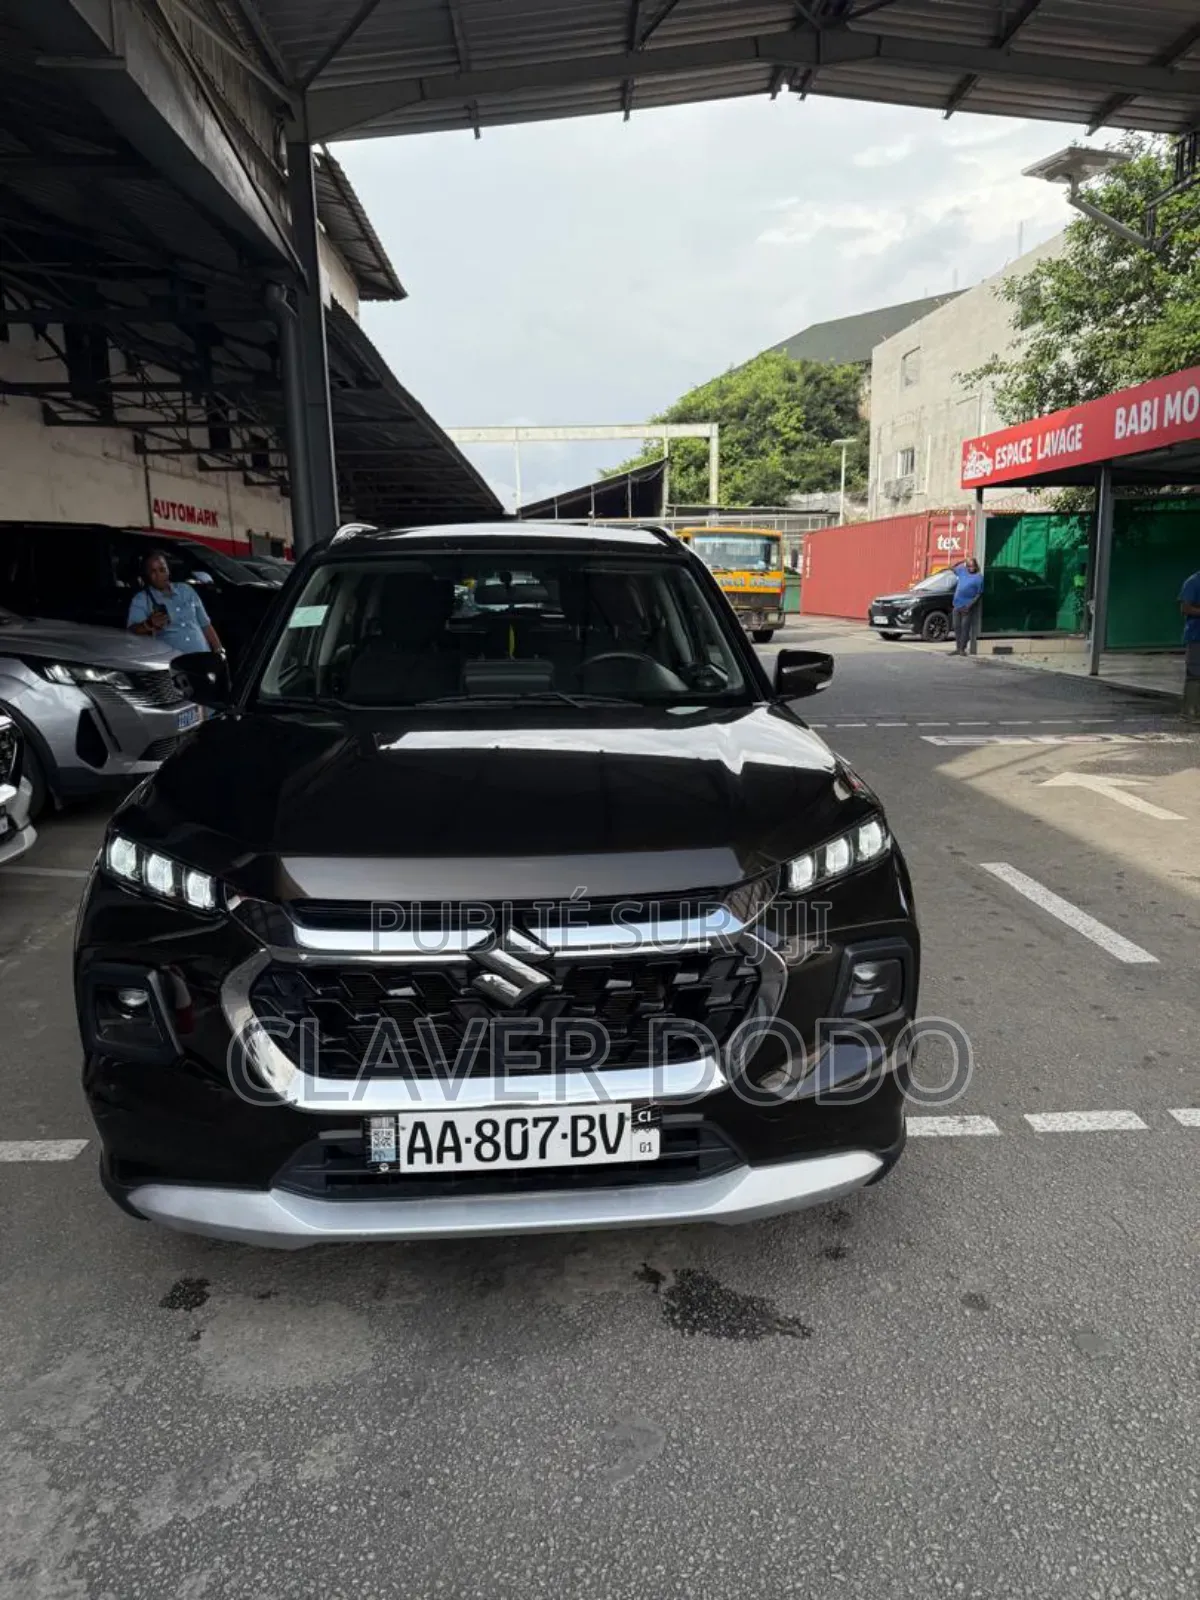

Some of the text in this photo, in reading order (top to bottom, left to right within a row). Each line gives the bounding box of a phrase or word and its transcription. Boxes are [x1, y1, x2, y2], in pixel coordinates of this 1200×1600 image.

[1115, 396, 1159, 440] BABI
[995, 423, 1083, 470] ESPACE LAVAGE
[153, 498, 218, 528] AUTOMARK
[937, 534, 960, 550] tex
[638, 1110, 651, 1122] CI
